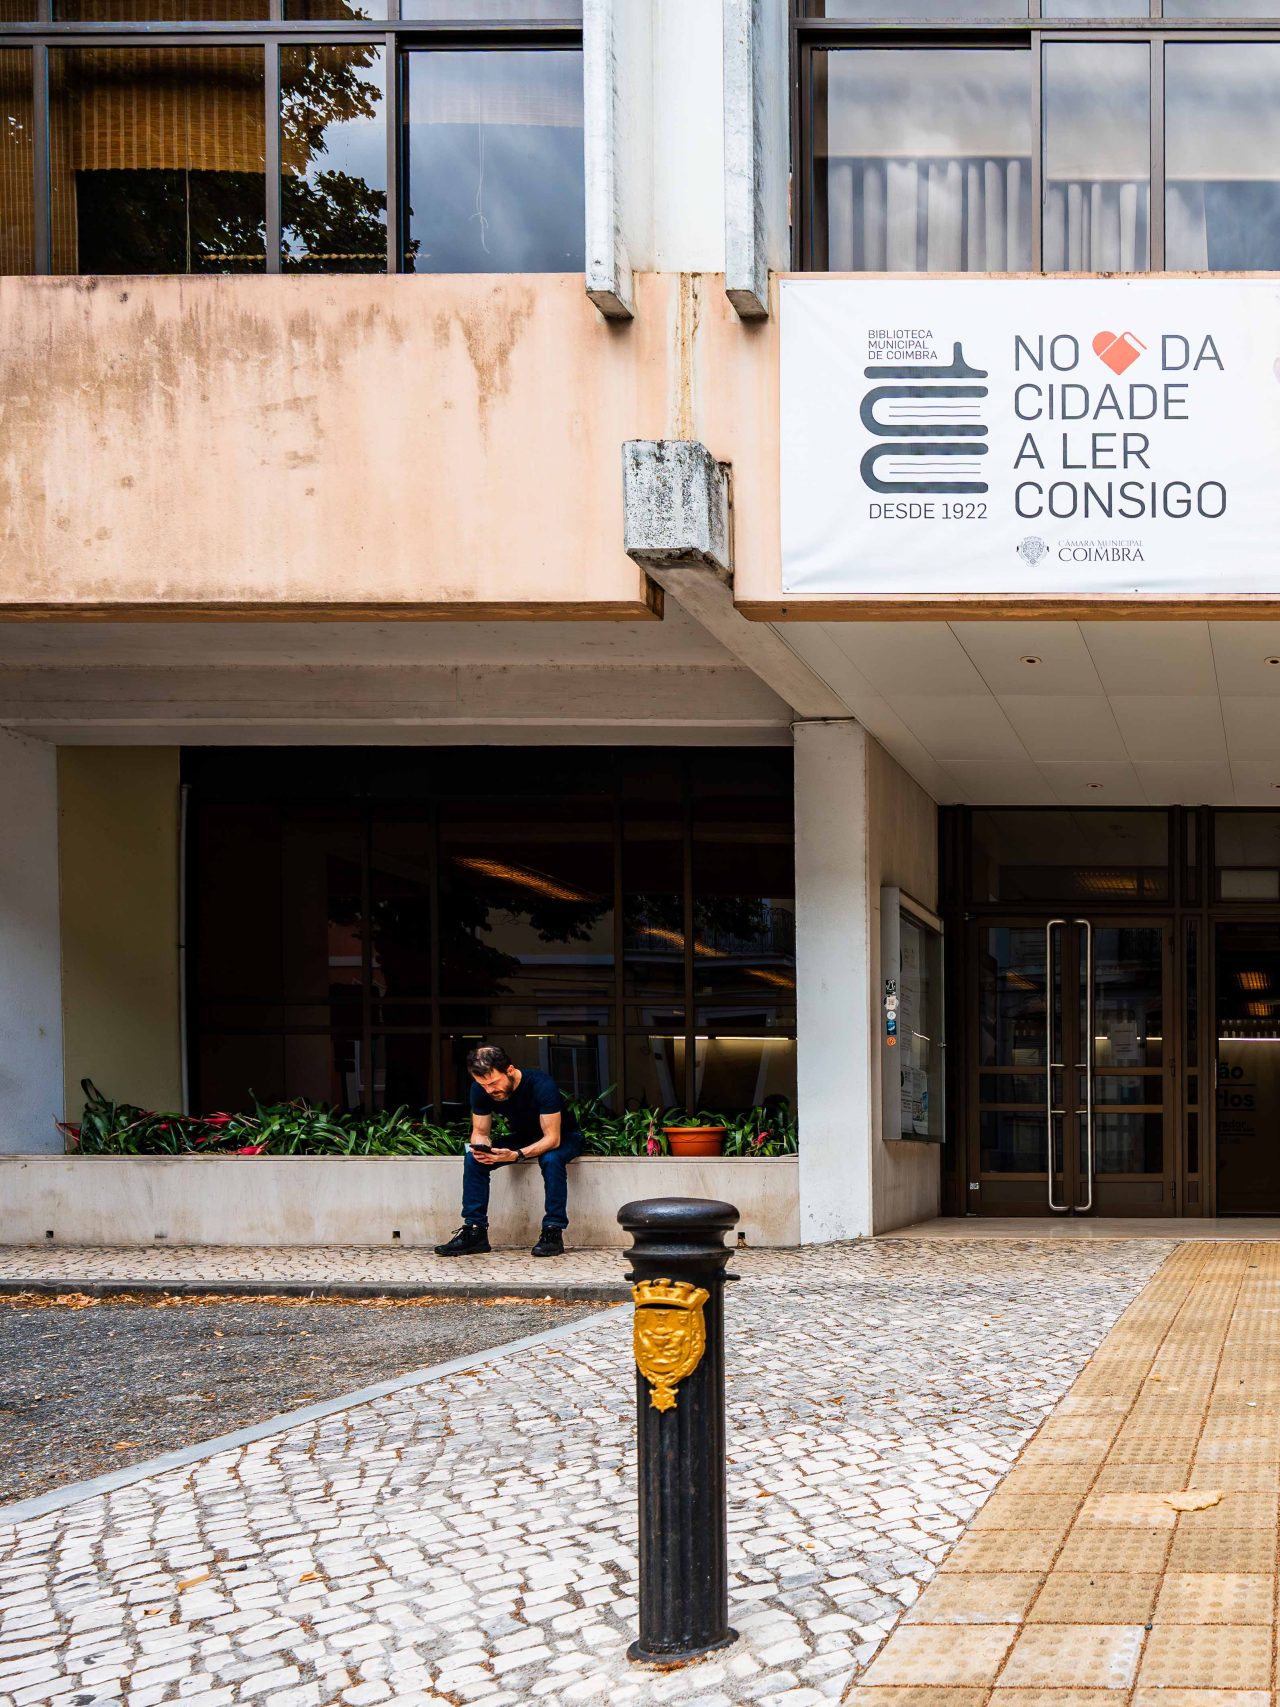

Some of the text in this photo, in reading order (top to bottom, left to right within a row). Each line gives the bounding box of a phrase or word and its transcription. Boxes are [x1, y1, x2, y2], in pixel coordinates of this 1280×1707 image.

[868, 329, 933, 339] BIBLIOTECA
[868, 340, 929, 350] MUNICIPAL
[1014, 334, 1225, 372] NO DA
[868, 350, 938, 360] DE COIMBRA
[1014, 383, 1189, 421] CIDADE
[1013, 432, 1151, 470] A LER
[1014, 481, 1227, 519] CONSIGO
[869, 503, 988, 519] DESDE 1922
[1058, 538, 1144, 547] CÂMARA MUNICIPAL
[1058, 547, 1145, 562] COIMBRA
[1219, 1062, 1243, 1079] ão
